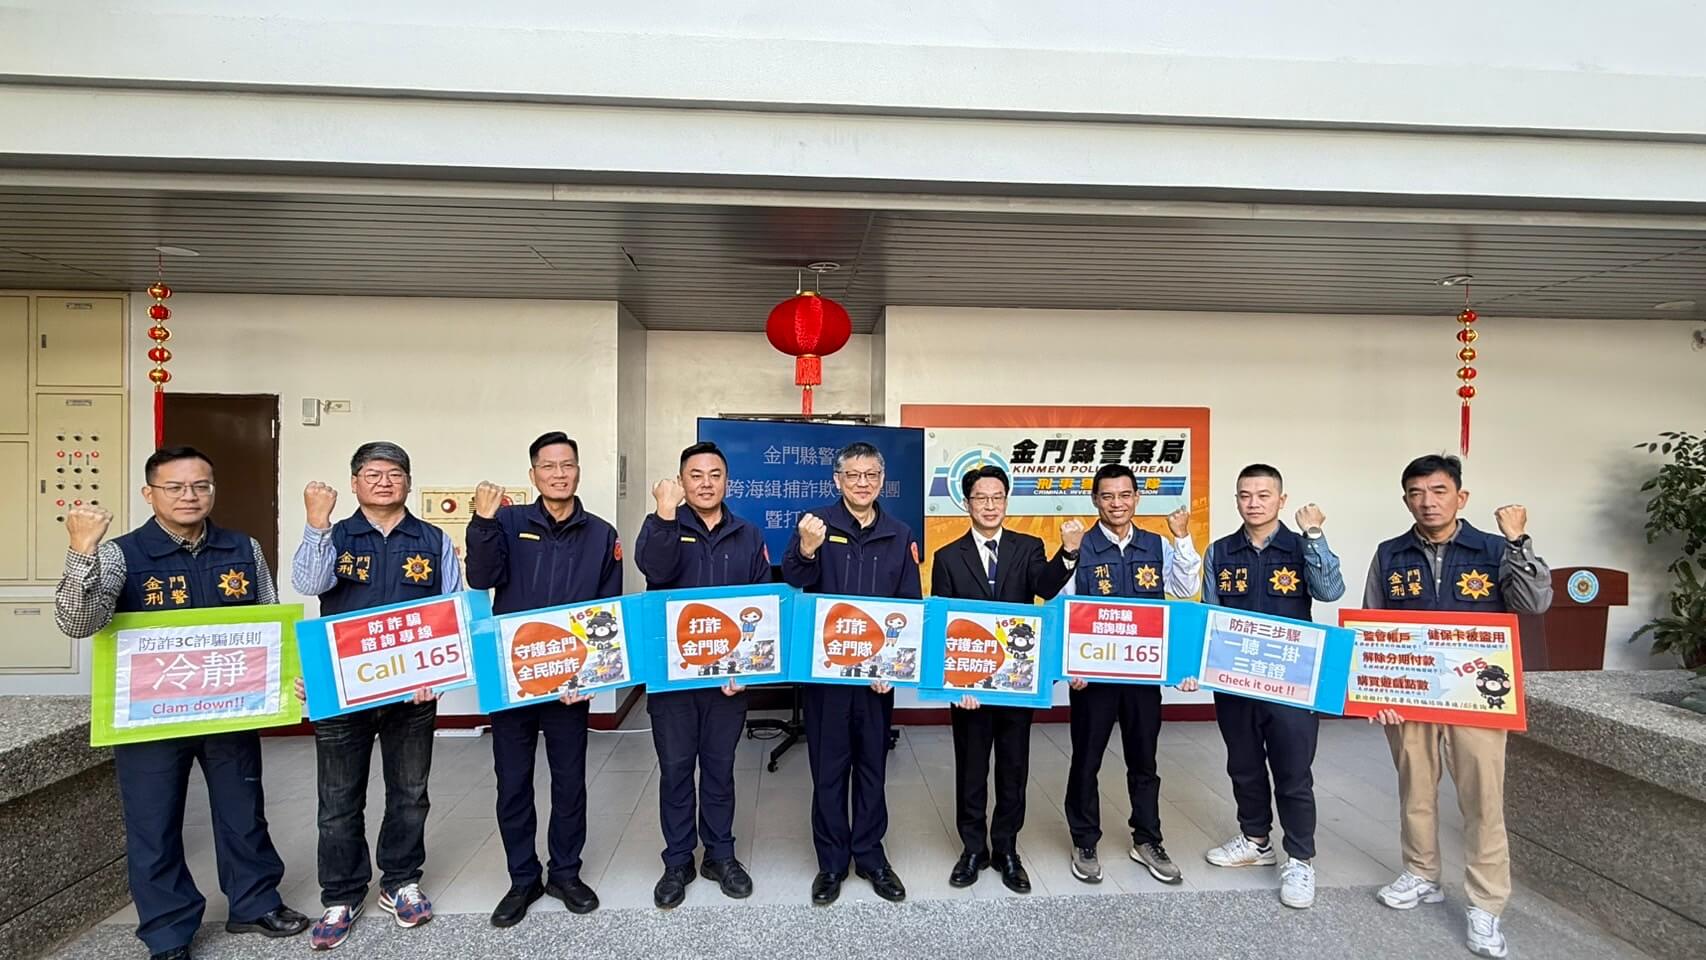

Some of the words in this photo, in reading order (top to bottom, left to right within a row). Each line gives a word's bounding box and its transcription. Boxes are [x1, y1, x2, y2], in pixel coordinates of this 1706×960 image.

[763, 445, 842, 465] 金門縣警
[1010, 439, 1185, 464] 金門縣警察局
[338, 551, 370, 569] 金門
[337, 564, 369, 580] 刑警
[1219, 568, 1247, 580] 金門
[1388, 569, 1421, 584] 金門
[143, 576, 187, 591] 金門
[1219, 580, 1248, 592] 刑警
[1391, 582, 1423, 596] 刑警
[144, 590, 189, 605] 刑警
[368, 612, 422, 635] 防詐騙
[570, 608, 593, 623] 165
[996, 618, 1016, 628] 165
[689, 617, 721, 634] 打詐
[836, 618, 867, 635] 打詐
[1229, 618, 1301, 642] 防詐三步驟
[139, 631, 262, 651] 防詐3C詐騙原則
[361, 625, 433, 653] 諮詢專線
[1428, 629, 1504, 643] 健保卡被盜用
[515, 636, 577, 660] 守護金門
[682, 639, 729, 656] 金門隊
[827, 640, 873, 657] 金門隊
[946, 637, 998, 654] 守護金門
[1080, 642, 1116, 660] Call
[1124, 645, 1159, 662] 165
[1224, 638, 1260, 656] 一聽
[1264, 643, 1300, 664] 二掛
[357, 654, 406, 683] Call
[414, 644, 460, 671] 165
[944, 657, 997, 673] 全民防詐
[1363, 652, 1435, 666] 解除分期付款
[1453, 657, 1488, 678] 165
[152, 650, 248, 691] 冷靜
[518, 657, 580, 682] 全民防詐
[1232, 656, 1286, 680] 三查證
[1219, 673, 1250, 687] Check
[1253, 681, 1261, 690] it
[1264, 684, 1283, 694] out
[1286, 685, 1296, 696] !!
[152, 701, 189, 715] Clam
[194, 697, 245, 711] down!!
